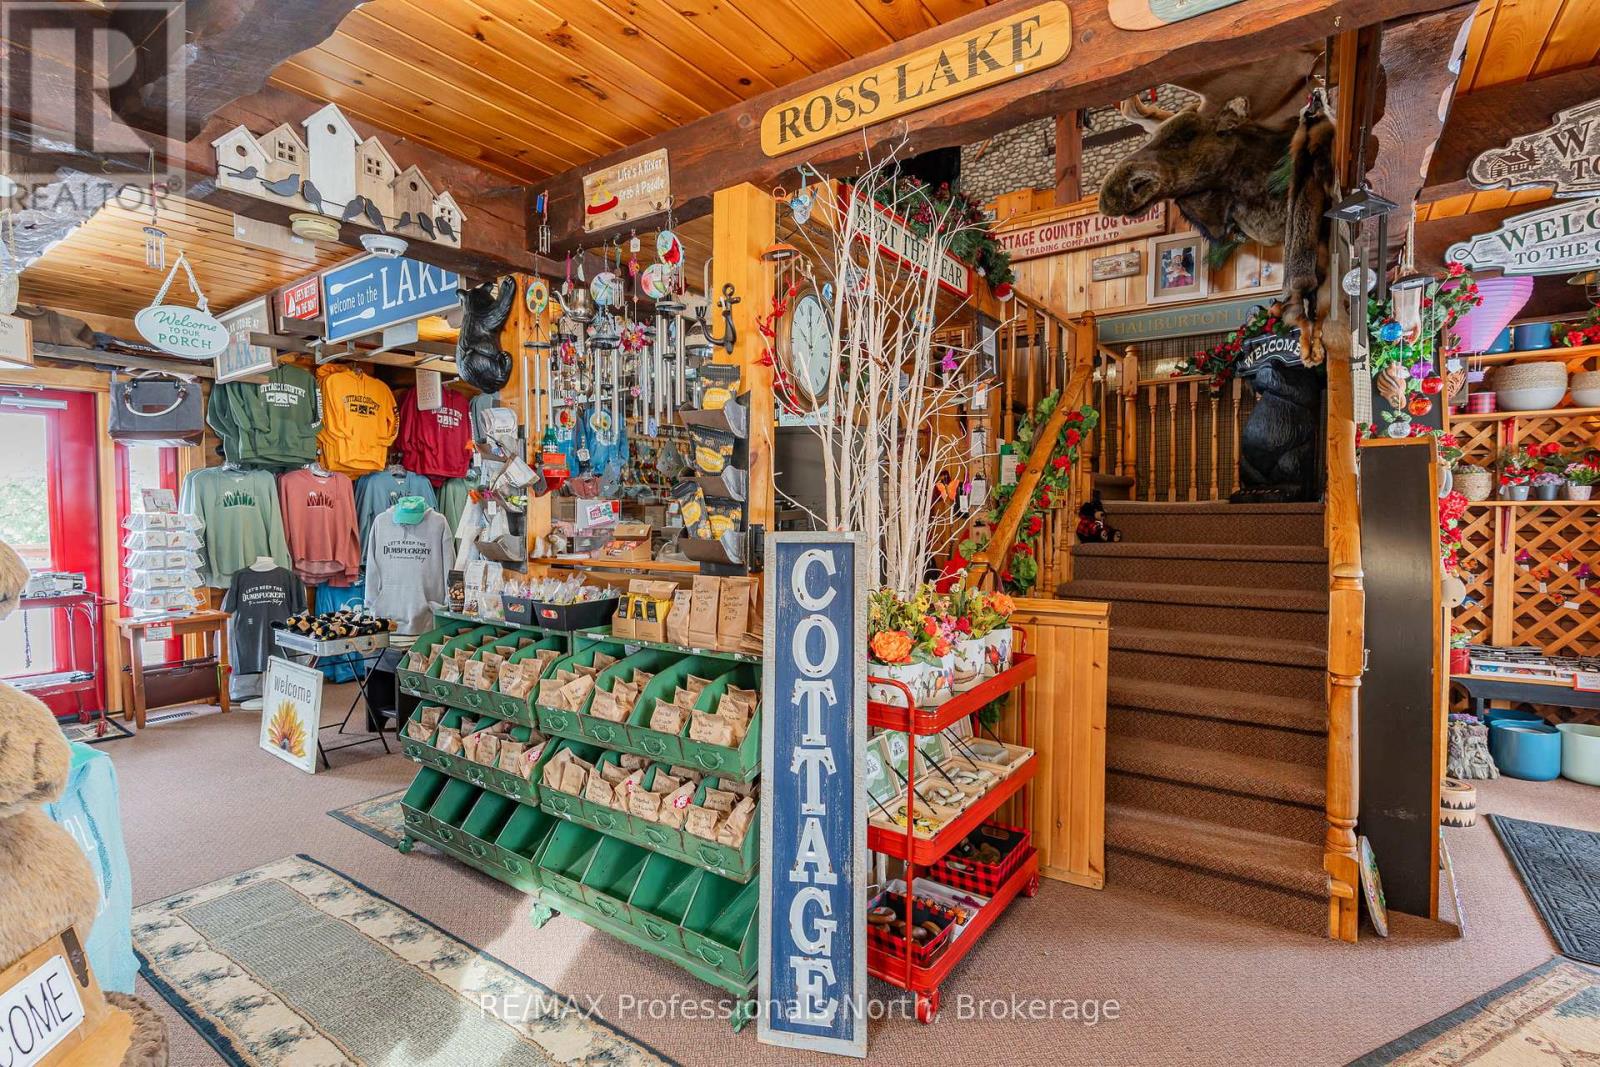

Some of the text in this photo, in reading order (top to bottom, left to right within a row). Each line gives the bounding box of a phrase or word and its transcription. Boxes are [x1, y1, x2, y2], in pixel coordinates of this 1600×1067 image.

[776, 15, 1044, 145] ROSS LAKE
[1025, 231, 1120, 255] TRADING COMPANY LTD
[1039, 217, 1091, 243] COUNTRY
[1094, 214, 1118, 232] LOG
[1515, 250, 1541, 265] TO
[1545, 242, 1588, 261] THE
[938, 255, 962, 288] EAR
[329, 294, 356, 315] welcome
[357, 292, 365, 306] to
[366, 286, 378, 303] the
[153, 310, 217, 332] Welcome
[169, 326, 199, 337] TO OUR
[1113, 310, 1229, 335] HALIBURTON
[158, 333, 212, 350] PORCH
[1244, 338, 1301, 368] WELCOME
[274, 674, 312, 704] welcome
[788, 548, 840, 1029] COTTAGE
